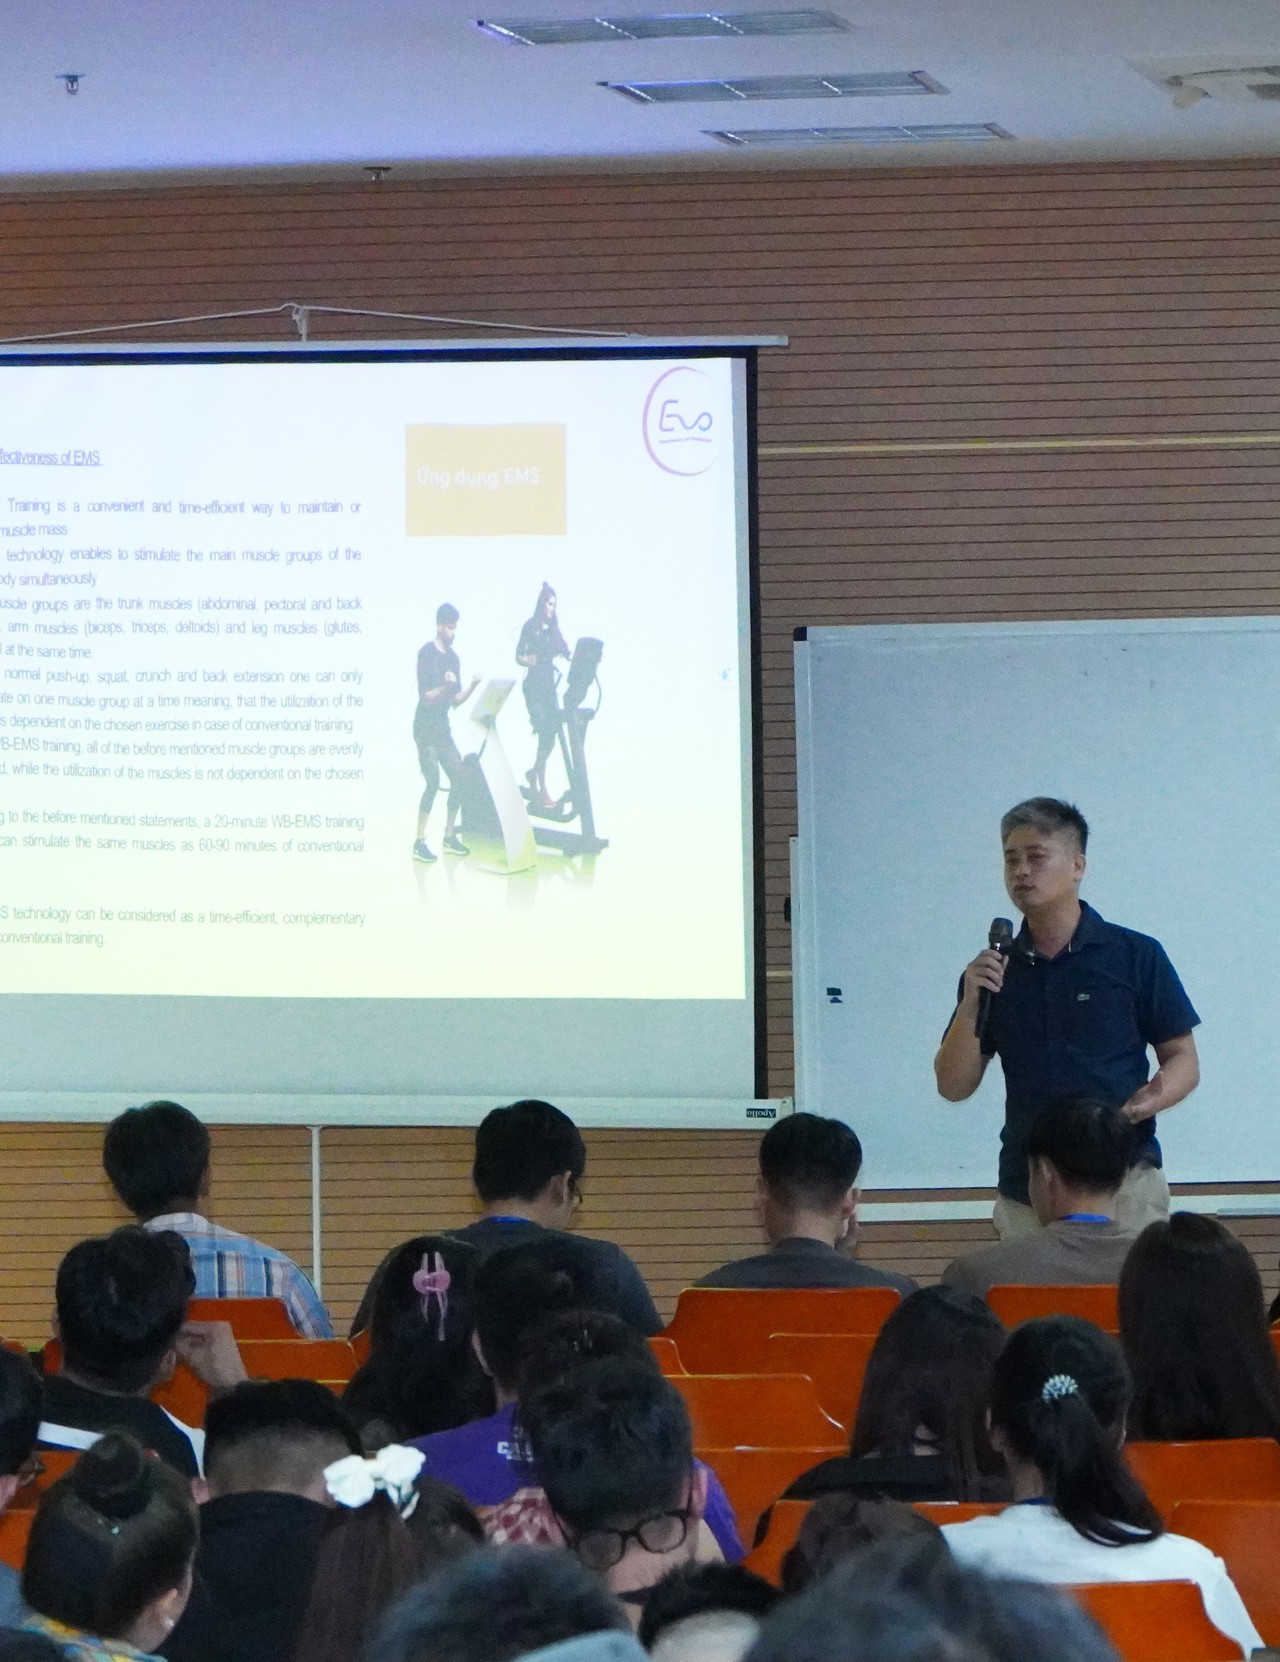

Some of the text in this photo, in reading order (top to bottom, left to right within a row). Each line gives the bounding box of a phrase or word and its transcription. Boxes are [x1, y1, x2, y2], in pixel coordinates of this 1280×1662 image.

[61, 450, 72, 465] of
[73, 450, 101, 466] EMS
[504, 466, 541, 485] EMS
[7, 496, 51, 515] Training
[86, 499, 145, 512] convenient
[151, 499, 172, 513] and
[178, 499, 246, 514] time-efficient
[251, 503, 274, 517] way
[280, 500, 292, 514] to
[297, 499, 344, 513] maintain
[350, 502, 362, 513] or
[38, 524, 68, 535] mass
[6, 546, 65, 564] technology
[69, 546, 112, 560] enables
[117, 547, 129, 560] to
[134, 546, 182, 561] stimulate
[186, 548, 204, 561] the
[208, 548, 236, 560] main
[241, 547, 280, 561] muscle
[285, 550, 323, 565] groups
[328, 546, 340, 560] of
[344, 546, 362, 560] the
[18, 570, 98, 588] simultaneously
[31, 599, 69, 614] groups
[73, 598, 92, 610] are
[95, 595, 113, 609] the
[116, 596, 144, 609] trunk
[148, 596, 193, 610] muscles
[197, 596, 259, 612] (abdominal,
[264, 597, 306, 613] pectoral
[310, 596, 332, 611] and
[336, 596, 363, 609] back
[7, 621, 29, 632] arm
[34, 621, 79, 635] muscles
[84, 619, 126, 637] (biceps,
[131, 620, 169, 635] triceps,
[174, 620, 220, 636] deltoids)
[224, 620, 246, 633] and
[251, 620, 268, 637] leg
[273, 620, 318, 634] muscles
[323, 620, 362, 637] (glutes,
[17, 642, 35, 656] the
[36, 647, 67, 658] same
[68, 645, 94, 658] time.
[4, 667, 41, 680] normal
[46, 669, 92, 685] push-up,
[97, 669, 130, 686] squat,
[134, 668, 172, 682] crunch
[176, 668, 198, 681] and
[202, 668, 229, 682] back
[233, 670, 285, 682] extension
[289, 672, 311, 683] one
[315, 671, 336, 682] can
[340, 668, 364, 685] only
[16, 693, 31, 704] on
[33, 694, 55, 705] one
[57, 694, 96, 707] muscle
[98, 696, 130, 710] group
[157, 694, 181, 707] time
[183, 696, 233, 710] meaning,
[236, 694, 257, 707] that
[259, 694, 278, 707] the
[280, 693, 330, 707] utilization
[332, 693, 344, 707] of
[346, 693, 364, 707] the
[9, 713, 66, 729] dependent
[68, 718, 82, 729] on
[84, 716, 102, 730] the
[103, 717, 143, 731] chosen
[144, 720, 190, 731] exercise
[203, 720, 230, 730] case
[231, 716, 244, 731] of
[244, 717, 312, 731] conventional
[313, 717, 354, 734] training
[42, 738, 84, 756] training,
[86, 740, 99, 753] all
[100, 740, 112, 754] of
[112, 741, 131, 755] the
[132, 741, 167, 755] before
[169, 741, 226, 755] mentioned
[228, 741, 267, 755] muscle
[268, 744, 306, 758] groups
[308, 744, 327, 755] are
[328, 741, 364, 758] evenly
[11, 761, 40, 775] while
[42, 762, 60, 775] the
[62, 762, 111, 777] utilization
[113, 765, 125, 778] of
[127, 766, 145, 779] the
[147, 766, 192, 780] muscles
[206, 767, 224, 779] not
[226, 766, 284, 782] dependent
[286, 769, 302, 779] on
[304, 767, 322, 780] the
[324, 766, 364, 779] chosen
[8, 810, 20, 822] to
[22, 808, 40, 822] the
[42, 809, 77, 823] before
[79, 812, 136, 826] mentioned
[138, 814, 200, 828] statements,
[214, 814, 268, 828] 20-minute
[270, 813, 322, 828] WB-EMS
[325, 815, 365, 831] training
[22, 833, 70, 847] stimulate
[74, 834, 92, 848] the
[96, 838, 128, 849] same
[131, 837, 176, 851] muscles
[198, 837, 230, 851] 60-90
[234, 839, 277, 851] minutes
[282, 838, 293, 852] of
[297, 838, 365, 852] conventional
[12, 905, 72, 923] technology
[75, 909, 96, 920] can
[99, 907, 114, 920] be
[117, 908, 176, 922] considered
[209, 909, 279, 924] time-efficient,
[282, 911, 366, 927] complementary
[64, 931, 106, 948] training.
[748, 1109, 776, 1118] Apollo
